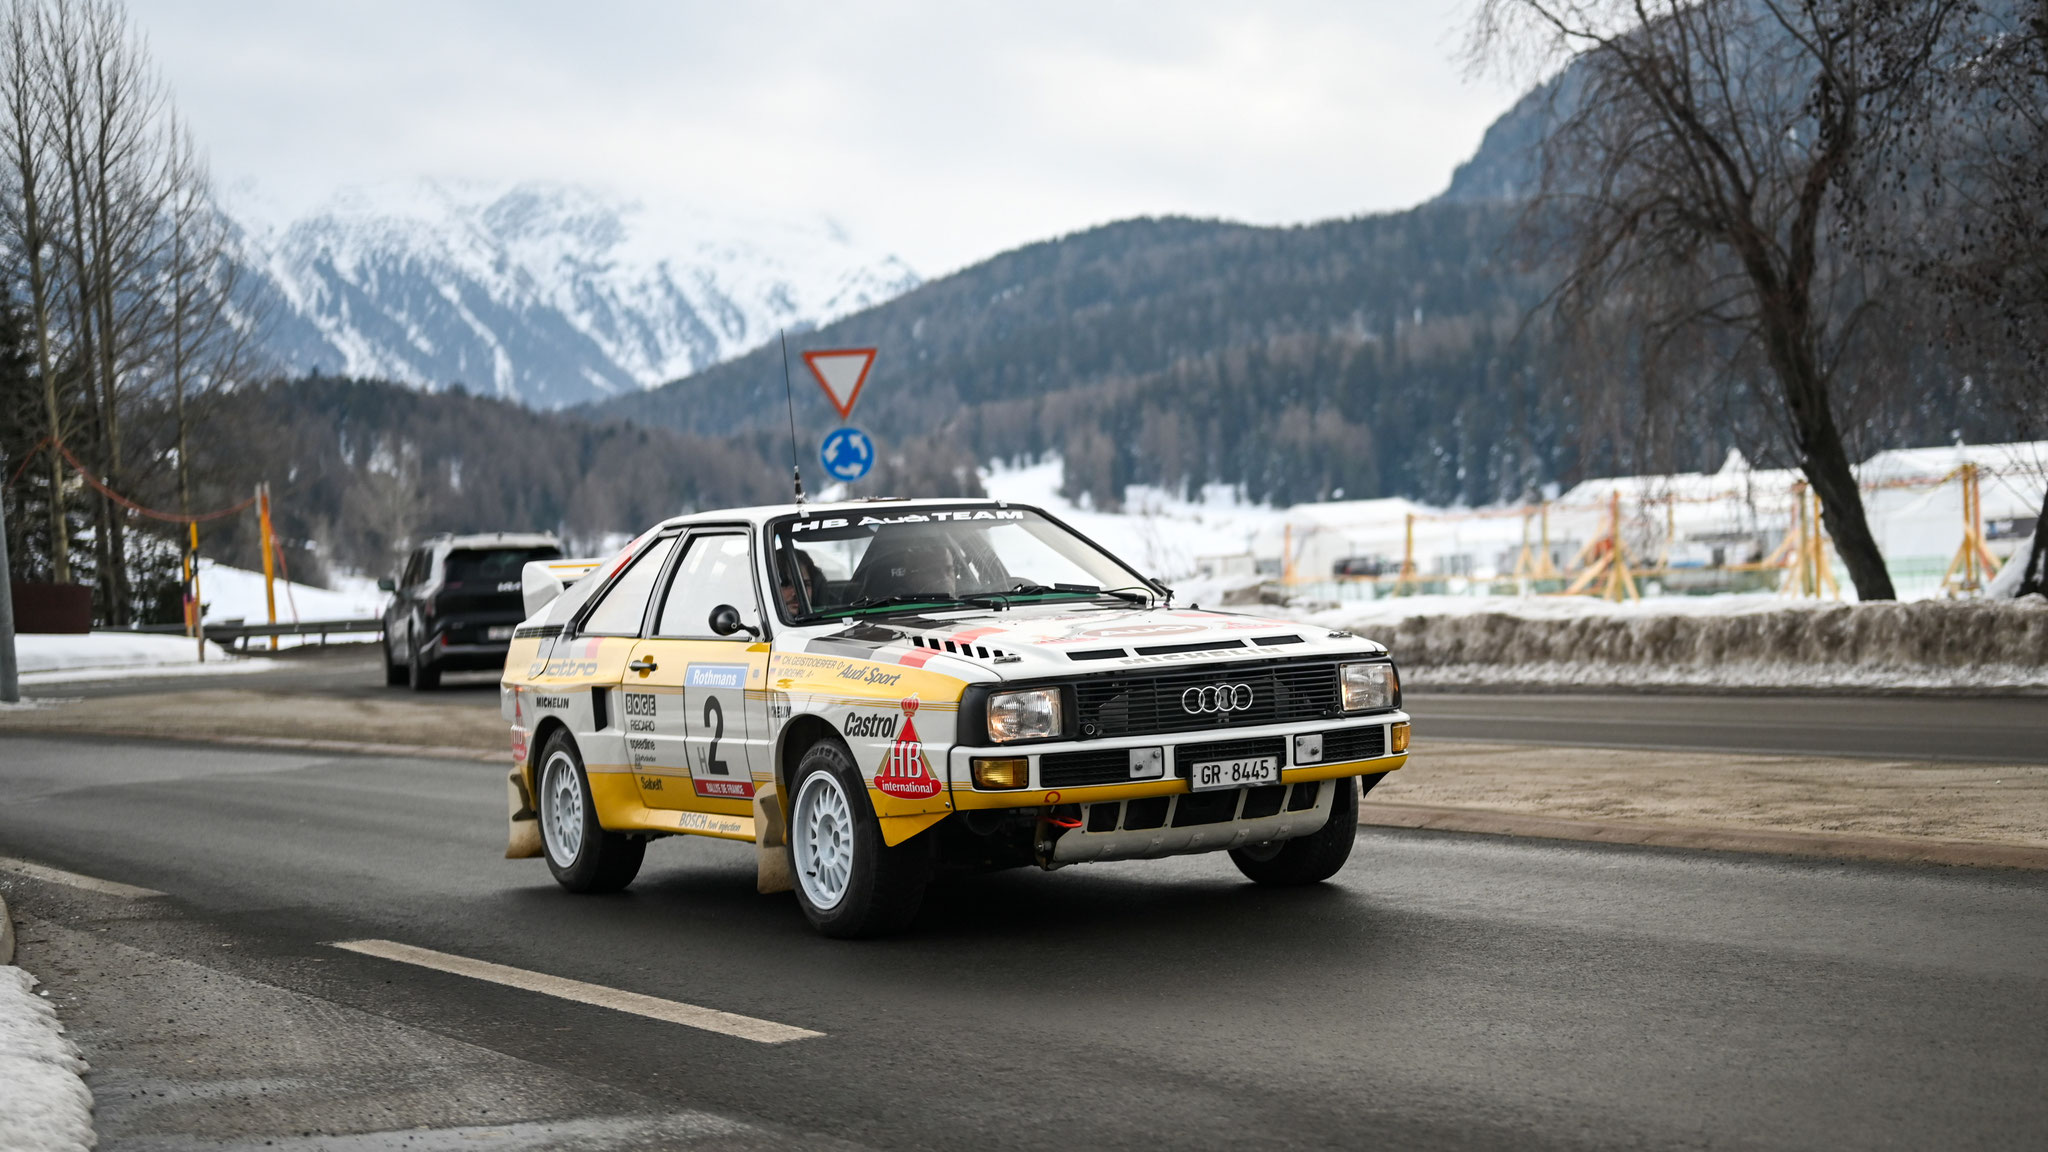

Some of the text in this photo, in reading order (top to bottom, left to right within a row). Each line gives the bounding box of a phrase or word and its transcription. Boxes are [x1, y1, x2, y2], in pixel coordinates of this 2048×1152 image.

[792, 511, 1024, 533] HB Audi TEAM
[1119, 647, 1285, 665] MICHELIN
[527, 660, 598, 678] quattro
[693, 669, 737, 686] Rothmans
[837, 664, 902, 686] Audi Sport
[536, 697, 569, 709] MICHELIN
[626, 694, 656, 716] BOGE
[630, 720, 656, 732] RECARO
[703, 695, 730, 776] 2
[844, 712, 899, 738] Castrol
[697, 746, 709, 775] H
[890, 740, 922, 778] HB
[1201, 760, 1270, 785] GR 8445
[881, 780, 934, 793] international
[679, 812, 741, 834] BOSCH fuel injection
